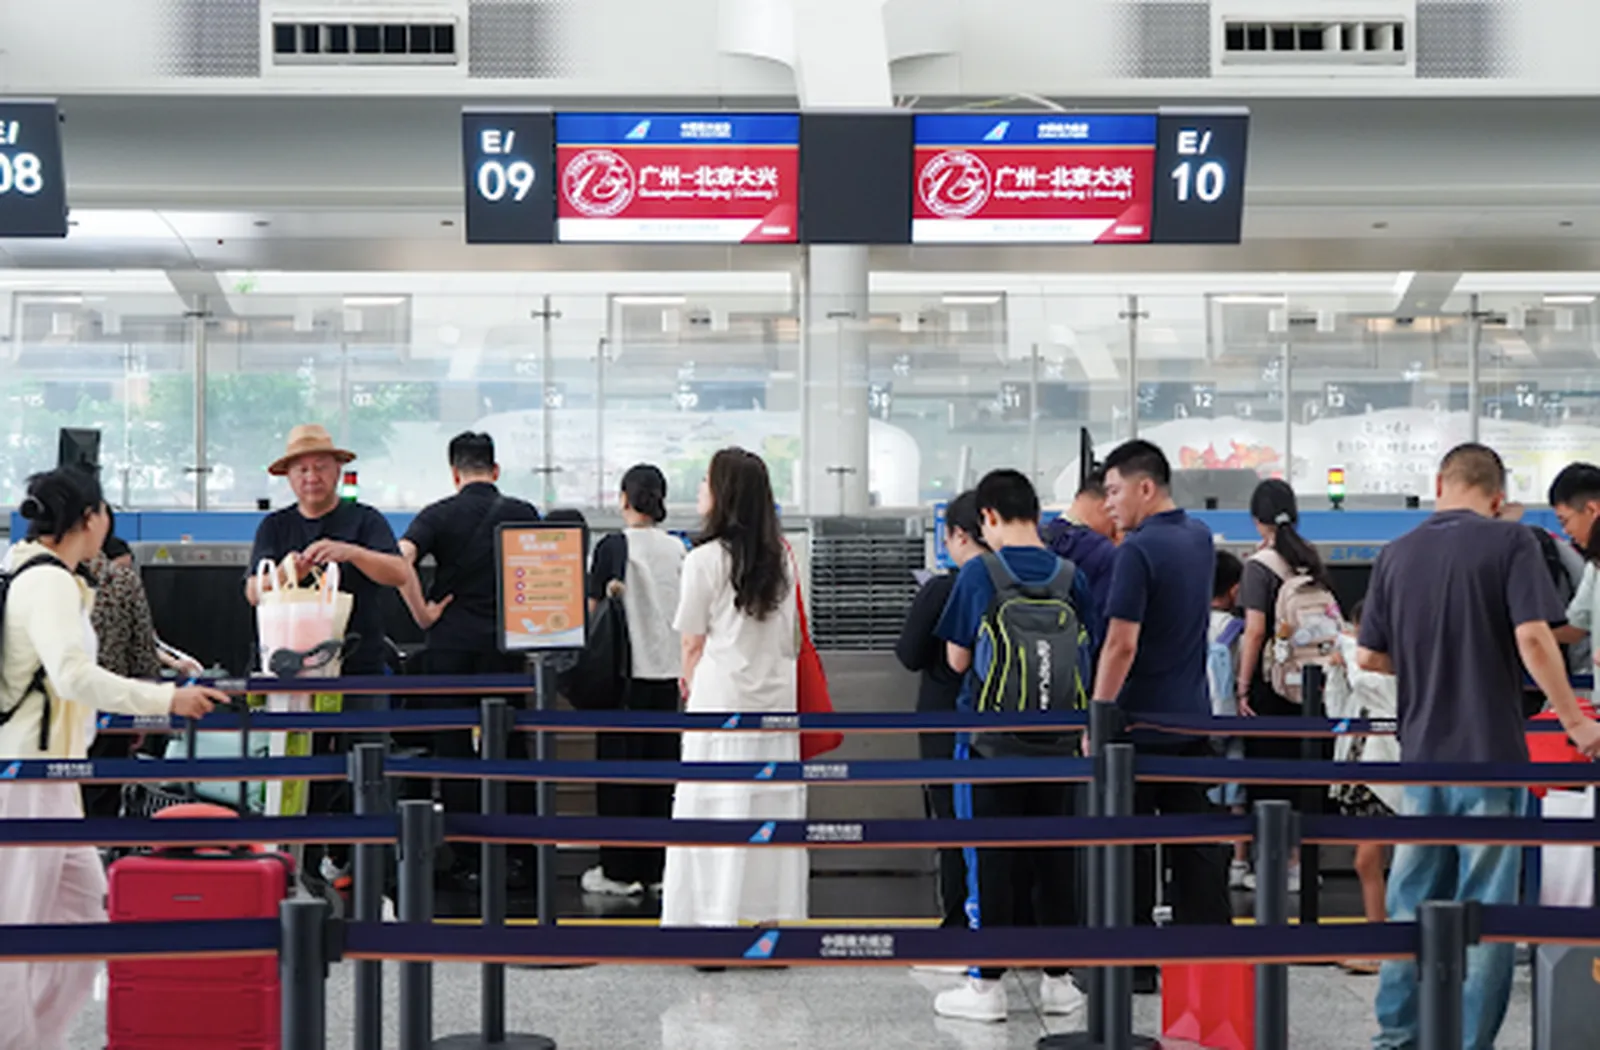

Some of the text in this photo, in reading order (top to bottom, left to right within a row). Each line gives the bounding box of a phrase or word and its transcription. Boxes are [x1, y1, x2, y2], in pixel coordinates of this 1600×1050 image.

[481, 129, 515, 154] E/
[1177, 130, 1212, 155] E/
[478, 160, 535, 201] 09
[1171, 161, 1225, 202] 10
[1195, 392, 1213, 408] 12
[1517, 393, 1535, 407] 14
